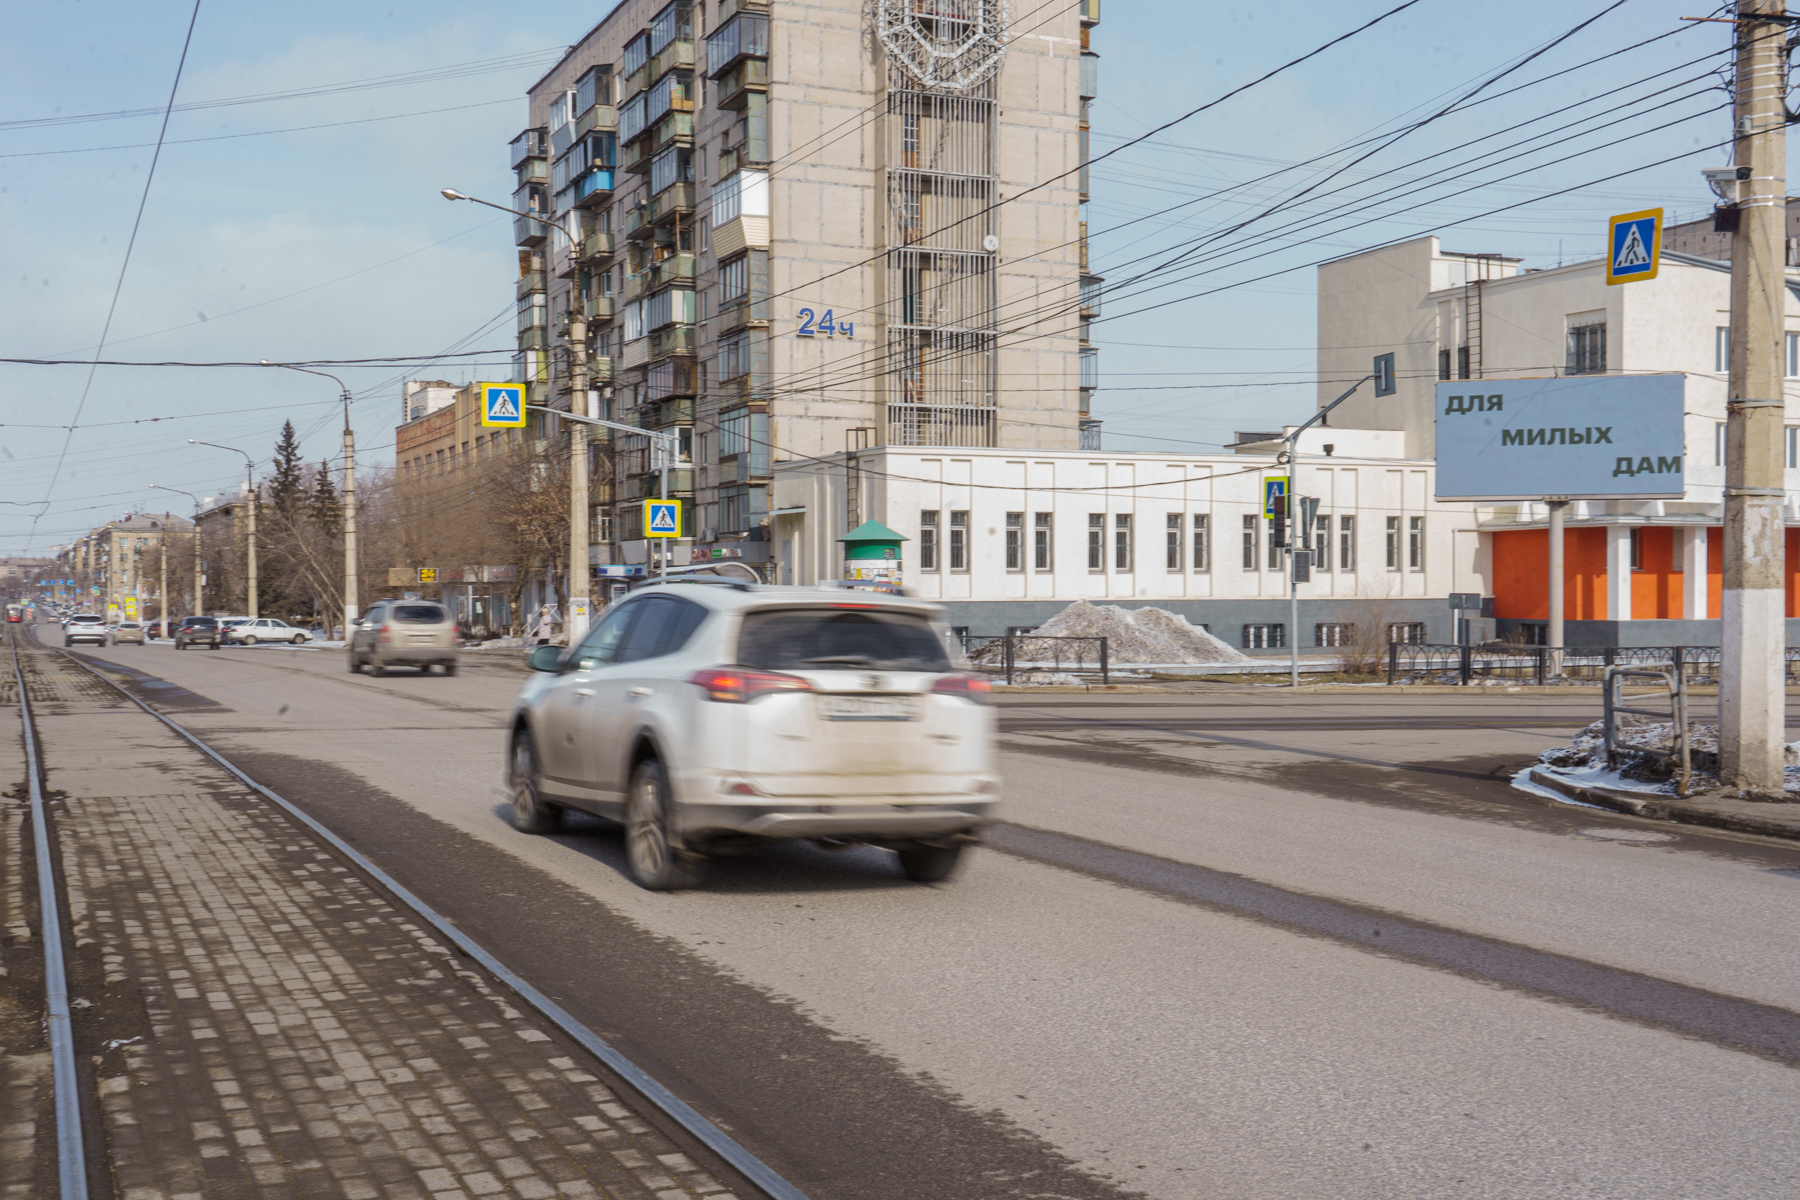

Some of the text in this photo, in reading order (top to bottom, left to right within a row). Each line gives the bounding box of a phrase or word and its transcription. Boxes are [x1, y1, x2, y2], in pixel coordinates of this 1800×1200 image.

[1445, 394, 1503, 415] ДЛЯ
[1502, 426, 1613, 446] МИЛЫХ
[1612, 456, 1682, 477] ДАМ
[420, 569, 435, 578] 24
